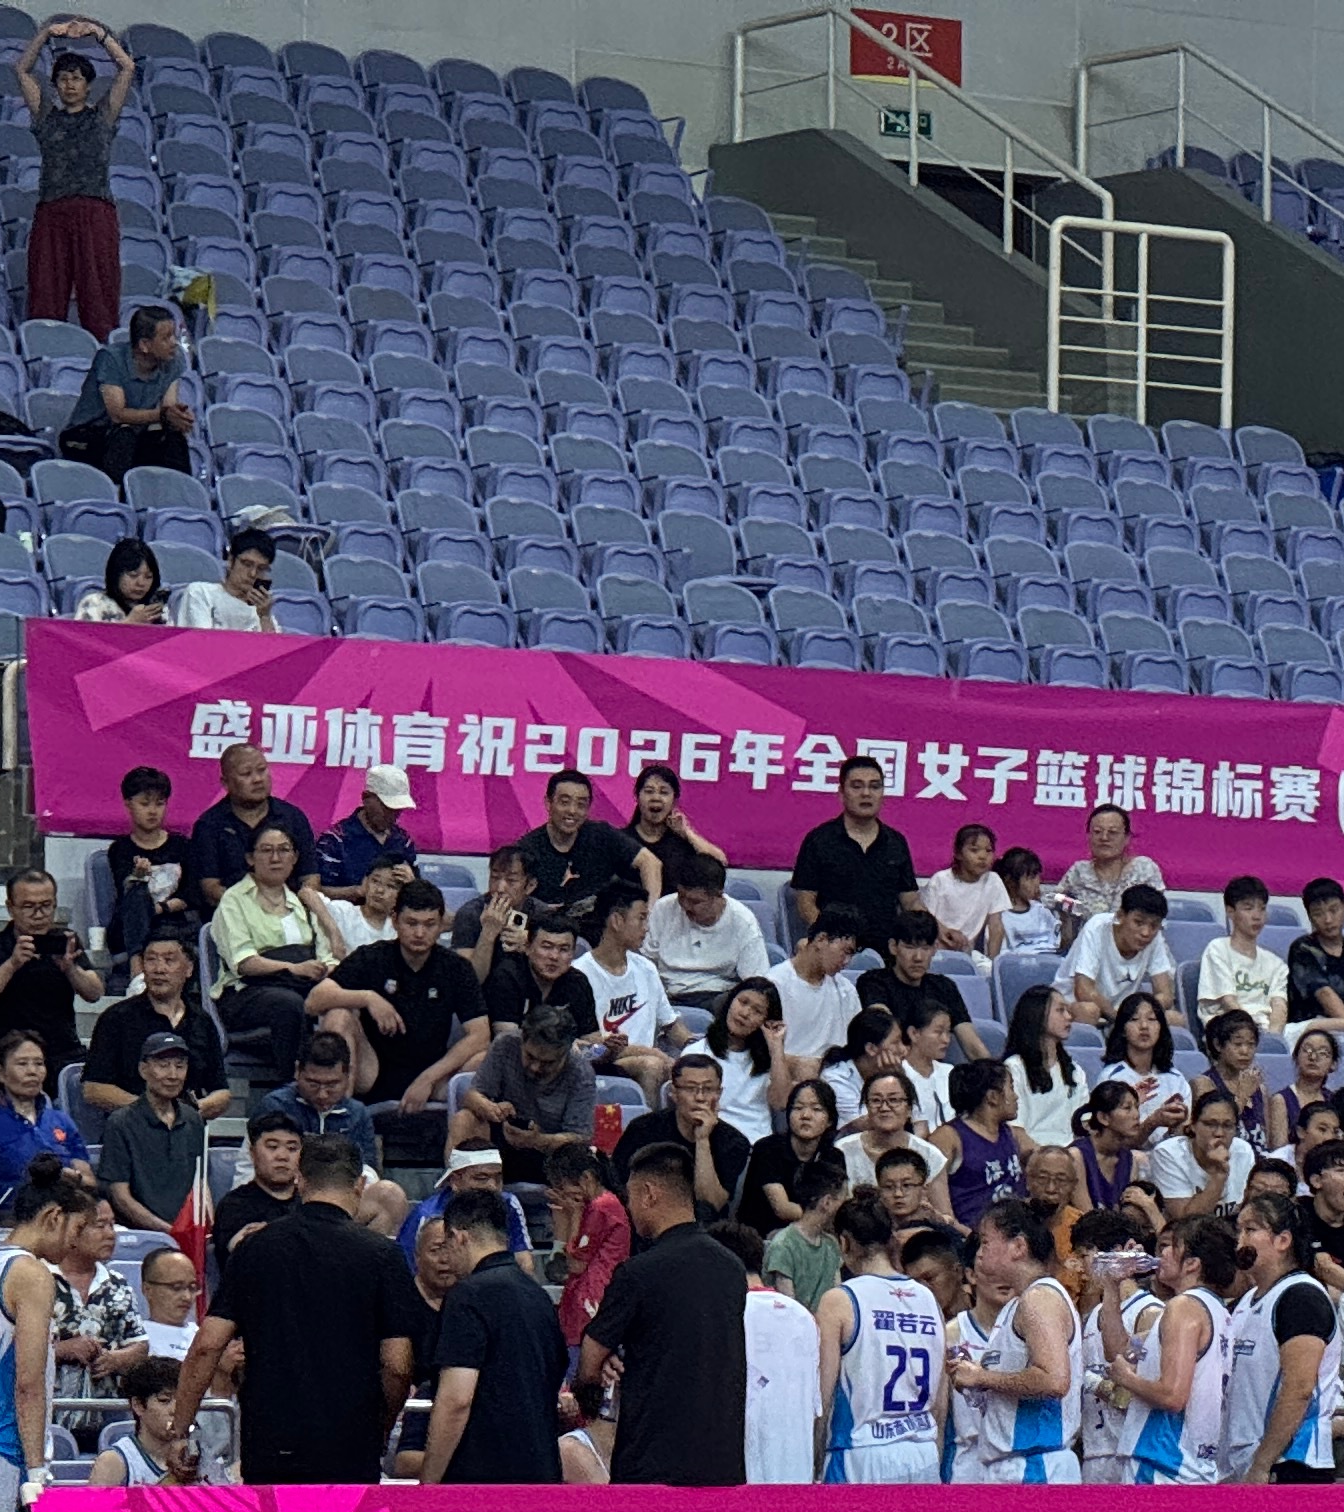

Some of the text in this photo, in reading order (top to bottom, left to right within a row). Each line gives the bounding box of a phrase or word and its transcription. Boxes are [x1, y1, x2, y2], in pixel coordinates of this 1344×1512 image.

[871, 1309, 937, 1336] 翟若云
[883, 1345, 930, 1411] 23
